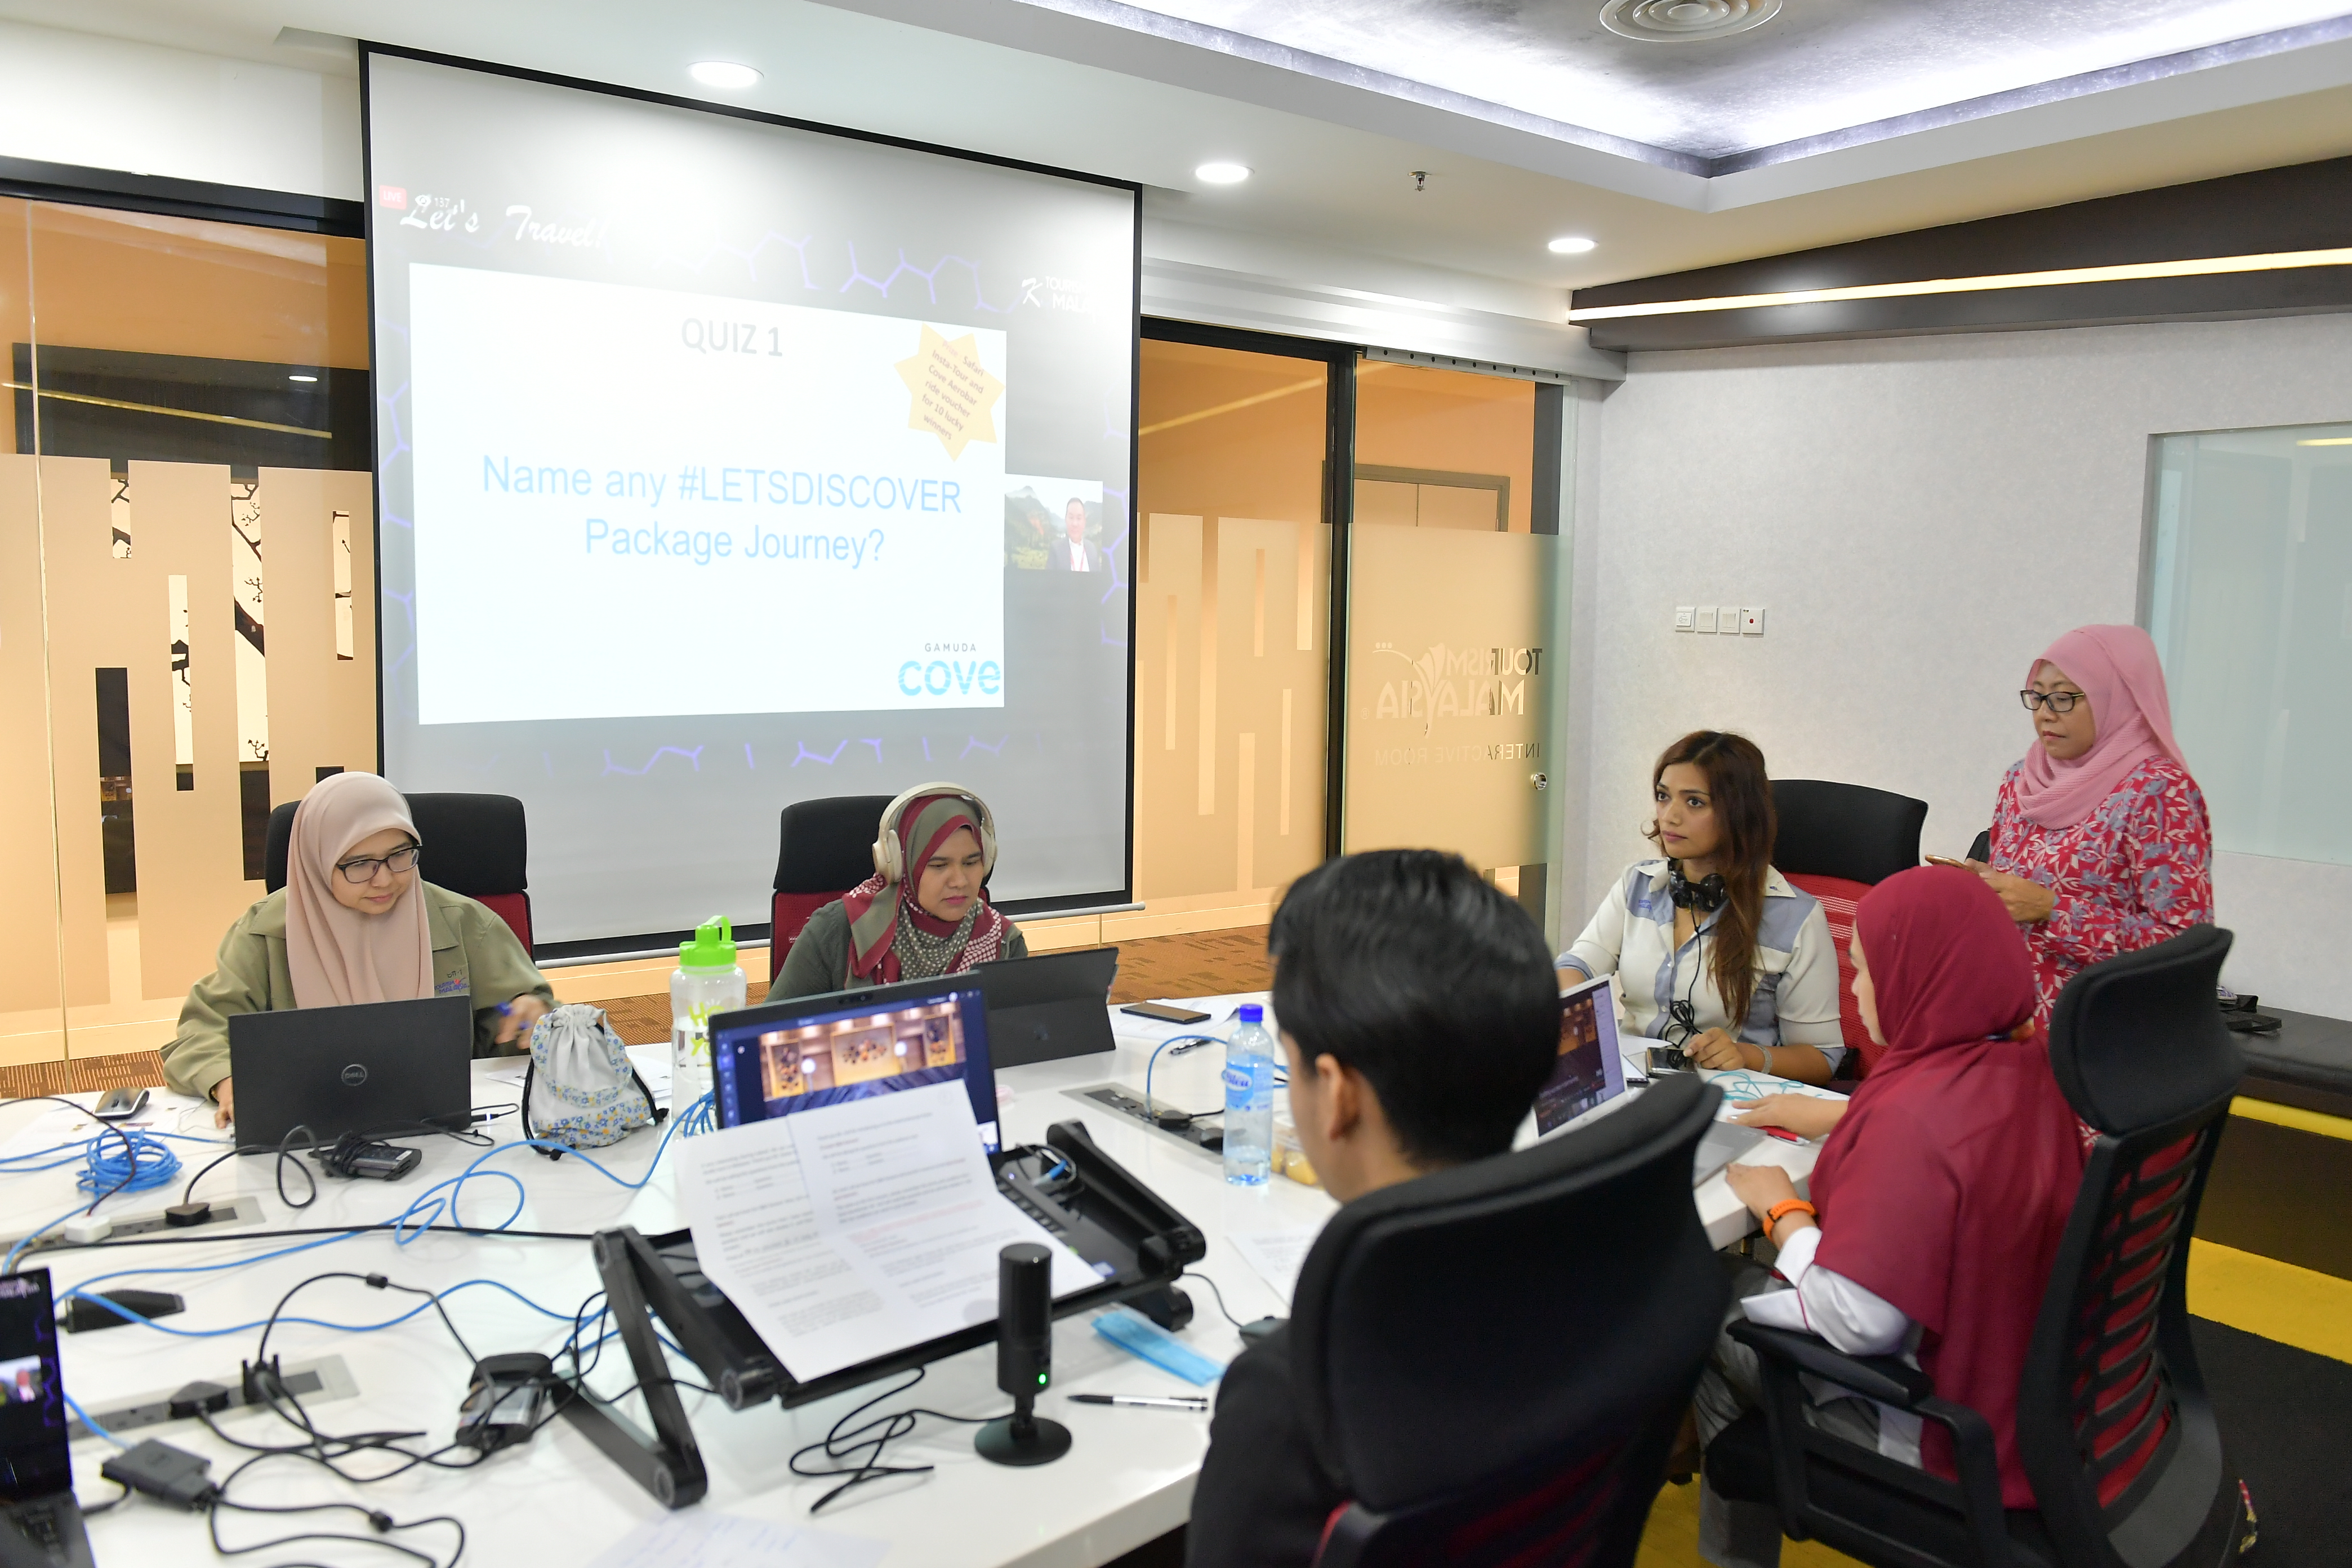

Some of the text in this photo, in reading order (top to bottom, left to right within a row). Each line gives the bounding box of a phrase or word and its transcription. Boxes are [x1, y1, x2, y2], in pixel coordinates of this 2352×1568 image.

[383, 190, 402, 202] LIVE
[434, 197, 451, 208] 137
[400, 194, 610, 250] Let's Travel!
[681, 318, 783, 357] QUIZ 1
[929, 364, 978, 406] Cove Aerobar
[932, 349, 984, 394] Insta-Tour and
[962, 355, 985, 377] Safari
[922, 394, 964, 432] for 10 lucky
[925, 380, 970, 418] ride voucher
[924, 414, 952, 440] winners
[483, 455, 962, 514] Name any #LETSDISCOVER
[585, 518, 884, 569] Package Journey?
[925, 643, 977, 652] GAMUDA
[898, 660, 1001, 697] cove
